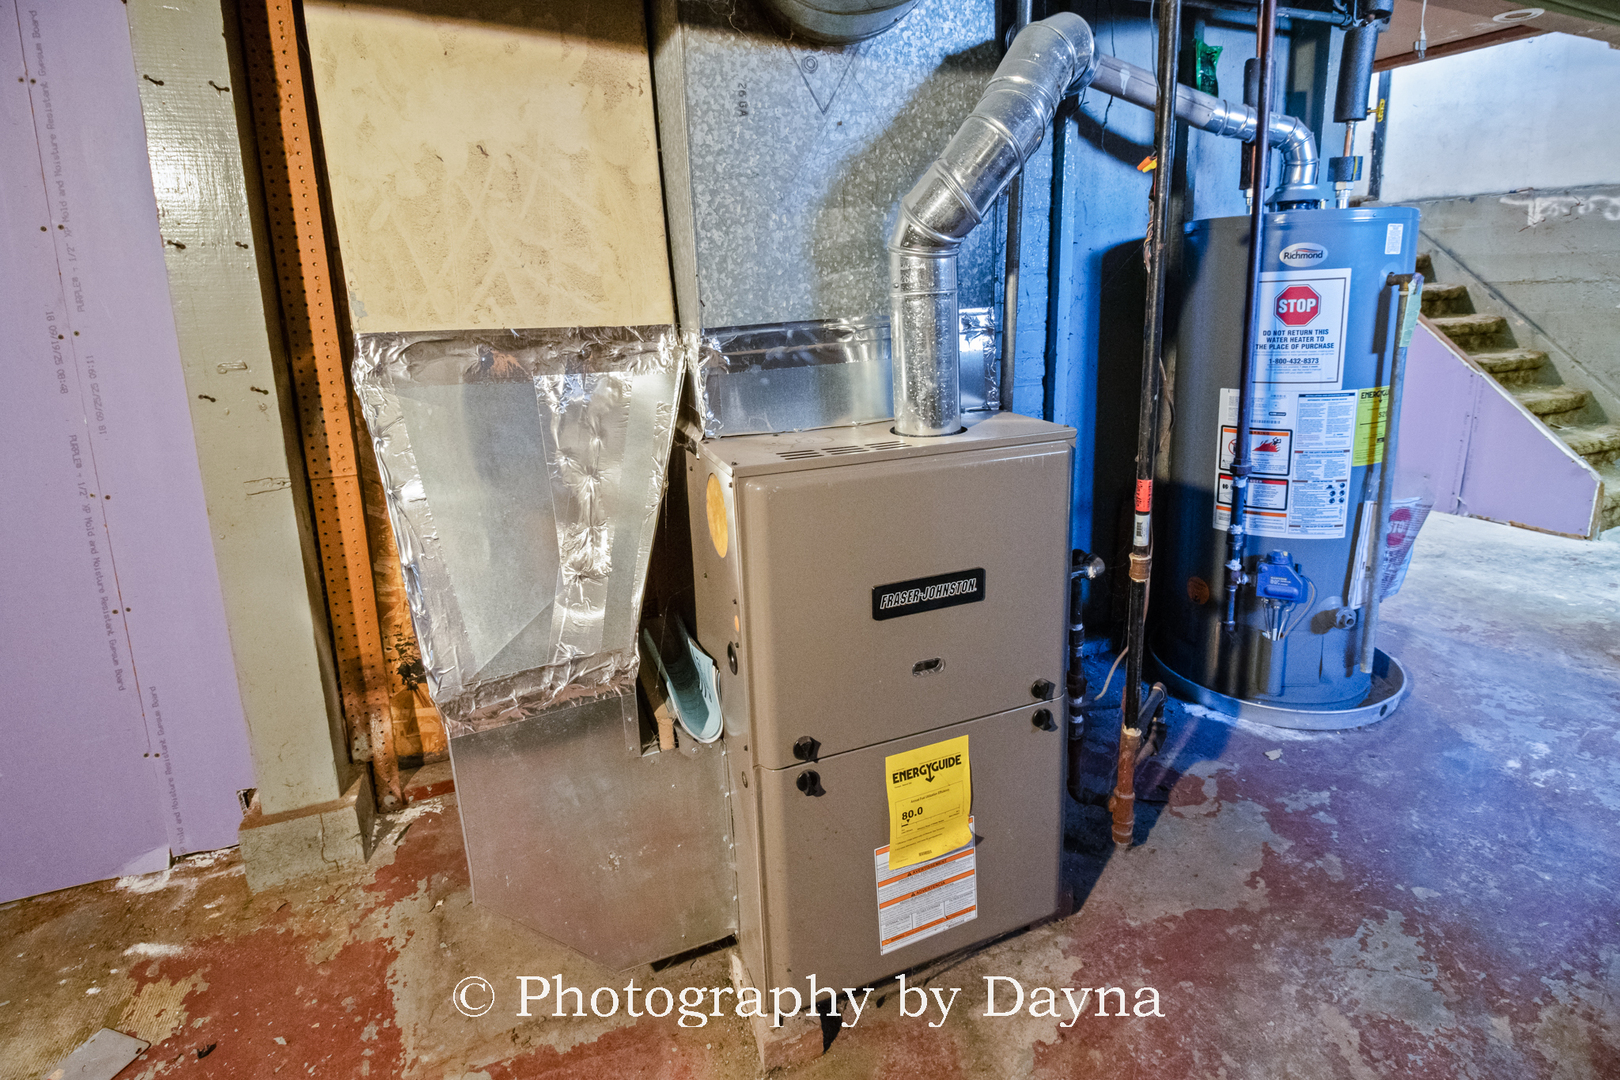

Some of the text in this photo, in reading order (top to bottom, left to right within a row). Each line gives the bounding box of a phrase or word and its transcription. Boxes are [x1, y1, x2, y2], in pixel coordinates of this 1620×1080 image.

[29, 9, 40, 38] Board
[35, 42, 46, 76] Gypsum
[40, 81, 54, 129] Resistant
[49, 133, 62, 177] Moisture
[56, 180, 66, 196] and
[59, 200, 69, 222] Mold
[1284, 250, 1324, 260] Richmond
[1278, 298, 1317, 313] STOP
[82, 503, 91, 513] XP
[85, 517, 95, 536] Mold
[89, 540, 98, 554] and
[93, 557, 105, 593] Moisture
[100, 596, 114, 635] Resistant
[108, 639, 119, 666] Gypsum
[115, 669, 124, 691] Board
[149, 686, 158, 707] Board
[159, 738, 171, 774] Resistant
[892, 754, 962, 784] ENERGYGUIDE
[167, 777, 178, 810] Moisture
[174, 812, 182, 824] and
[902, 807, 923, 820] 80.0
